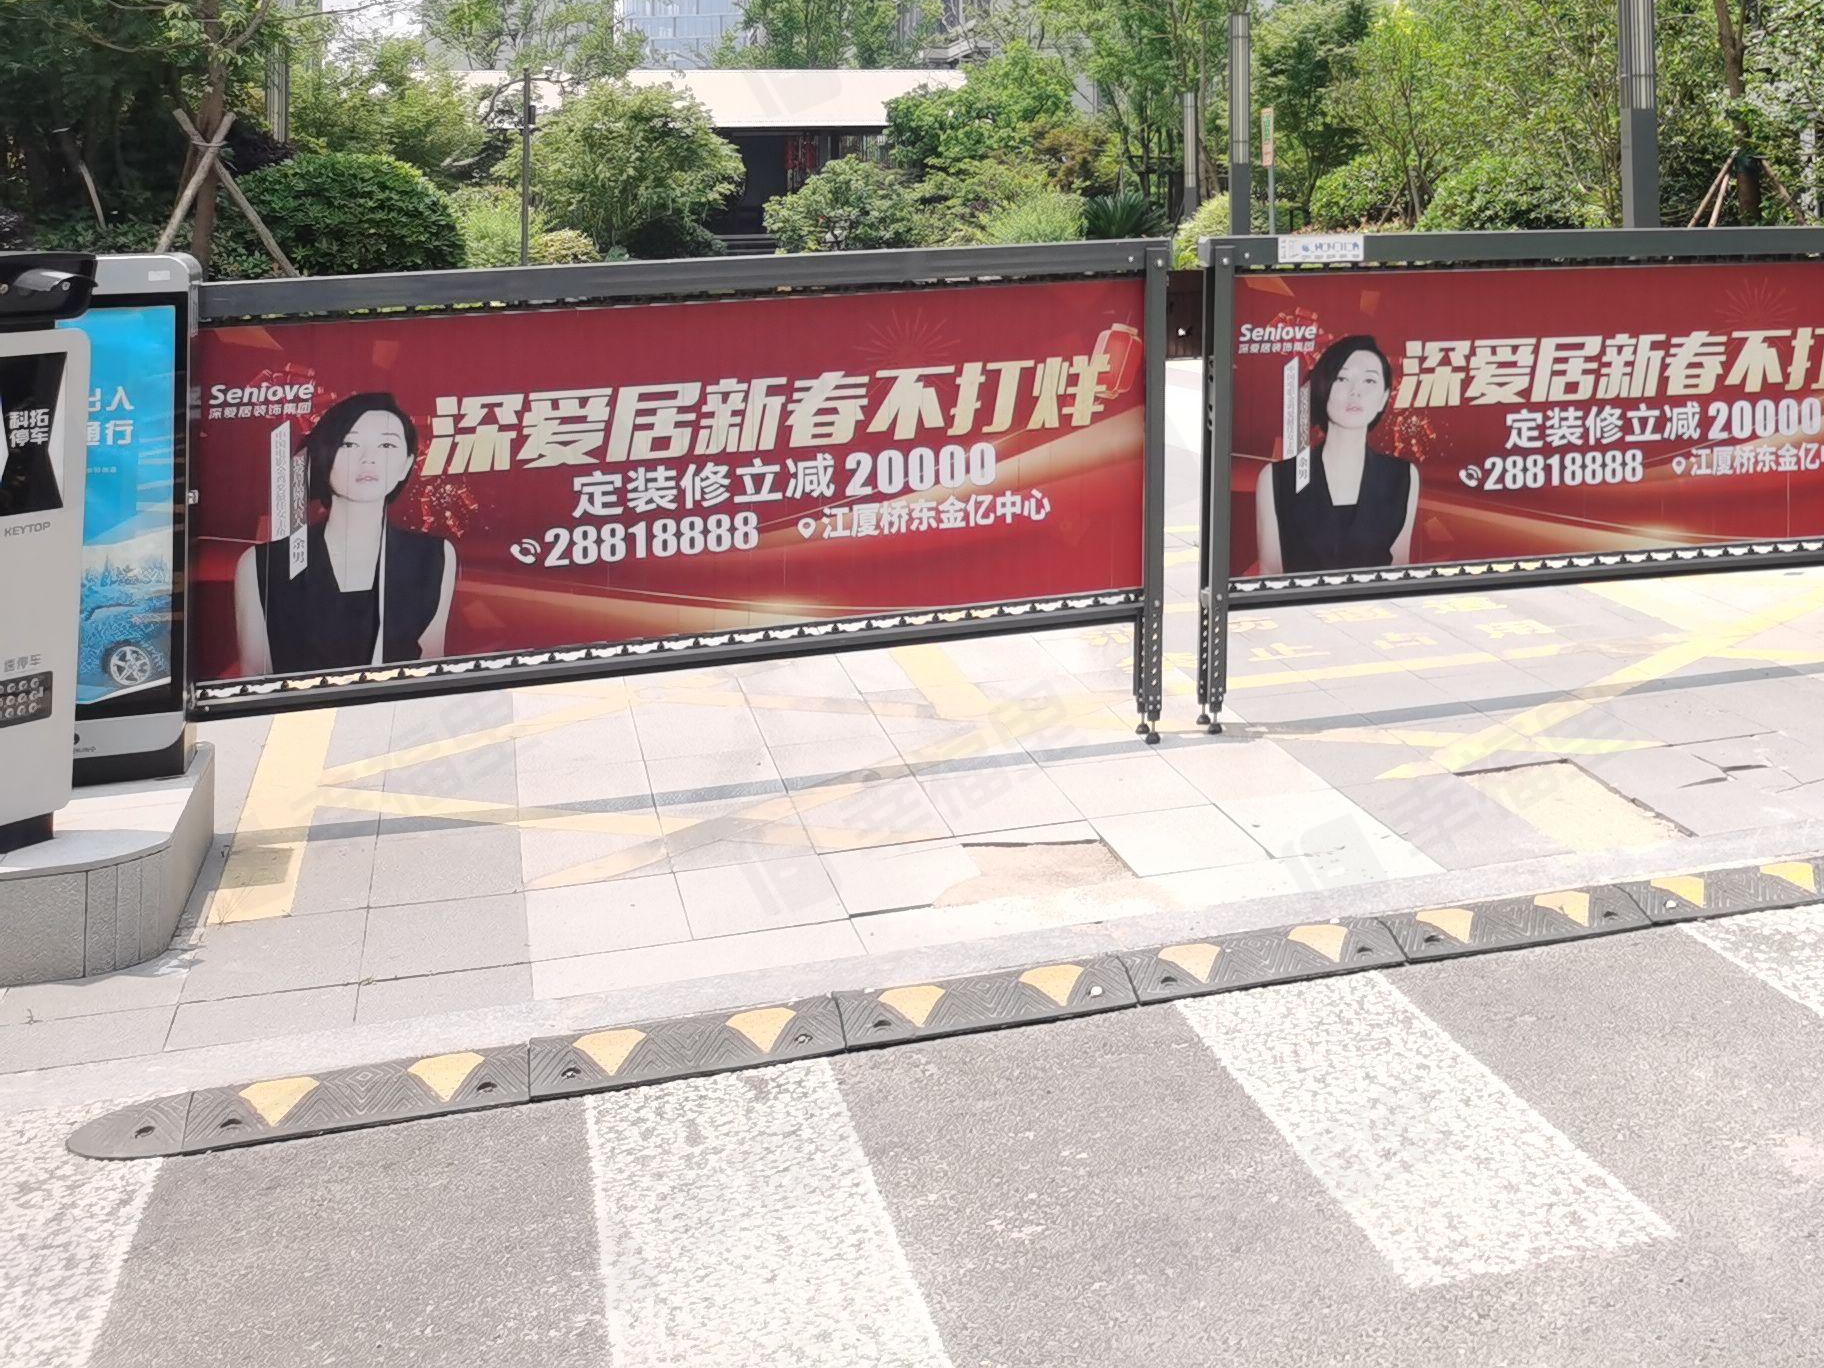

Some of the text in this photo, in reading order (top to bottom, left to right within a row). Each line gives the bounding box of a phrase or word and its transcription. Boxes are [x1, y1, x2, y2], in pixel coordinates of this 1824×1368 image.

[420, 354, 1111, 477] 深爱居新春不打烊
[1483, 449, 1643, 490] 28818888
[4, 521, 51, 536] KEYTOP
[544, 511, 758, 568] 28818888
[821, 489, 1050, 540] 江厦桥东金亿中心
